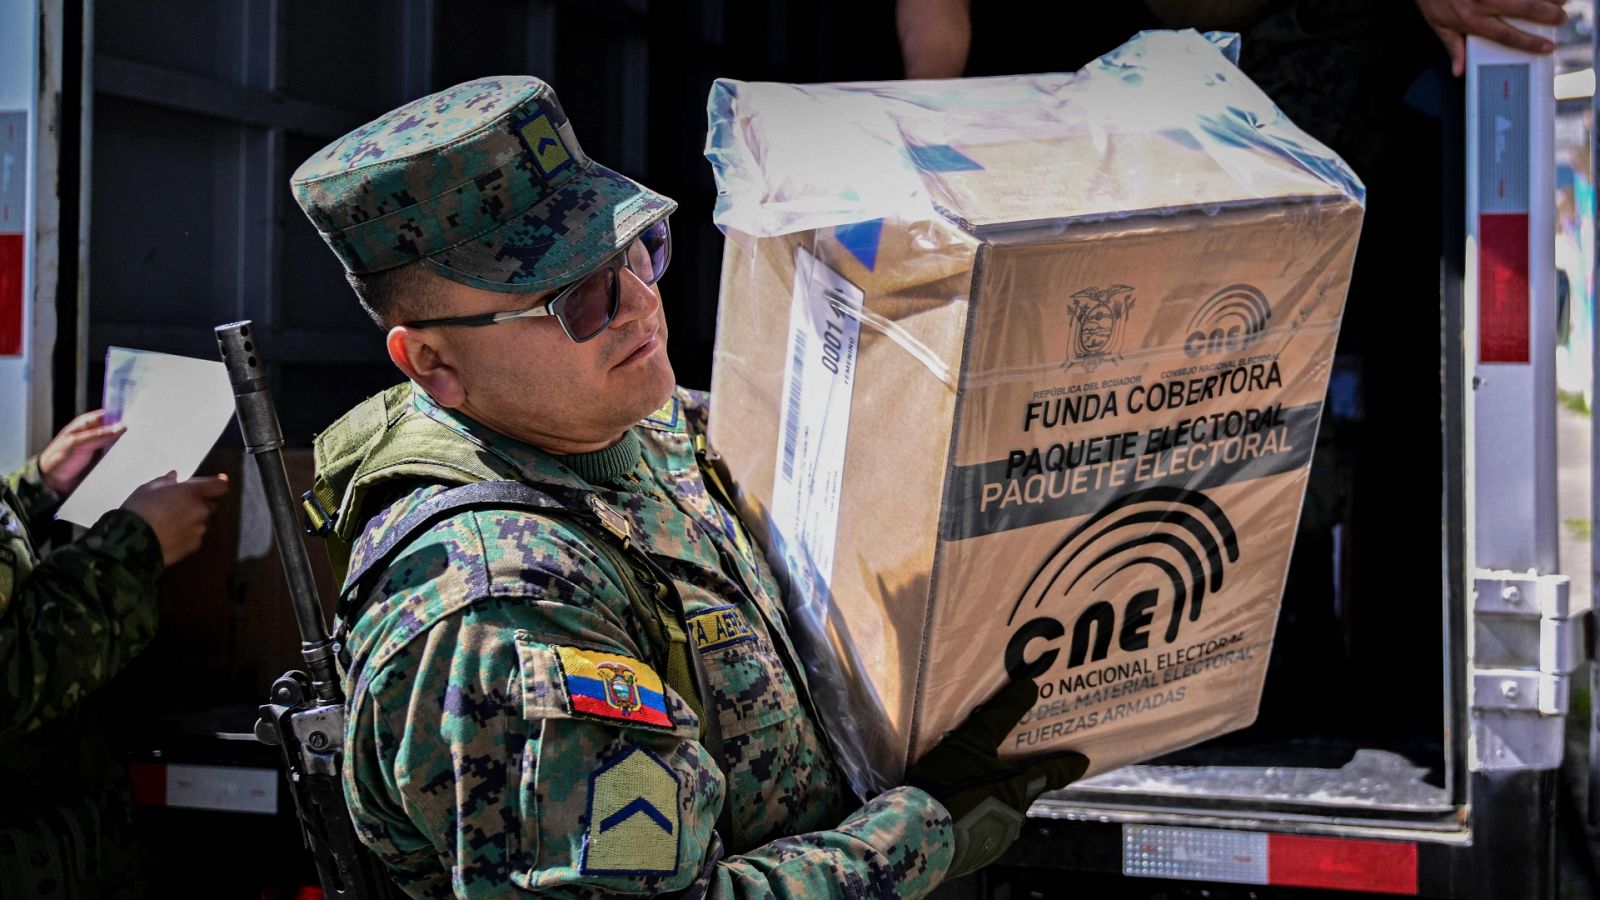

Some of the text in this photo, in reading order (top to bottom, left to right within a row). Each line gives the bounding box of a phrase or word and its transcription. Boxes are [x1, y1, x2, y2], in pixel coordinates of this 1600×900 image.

[821, 320, 844, 375] 0001
[1160, 364, 1198, 380] CONSEJO
[1024, 361, 1282, 432] FUNDA COBERTORA
[1033, 375, 1142, 400] REPÚBLICA DEL ECUADOR
[980, 426, 1293, 513] PAQUETE ELECTORAL
[1006, 402, 1287, 480] PAQUETE ELECTORAL
[1037, 699, 1070, 721] DEL
[1074, 672, 1160, 710] MATERIAL
[1163, 645, 1254, 684] ELECTORAL
[1059, 658, 1152, 695] NACIONAL
[1157, 632, 1244, 671] ELECTORAL
[1015, 685, 1187, 750] FUERZAS ARMADAS
